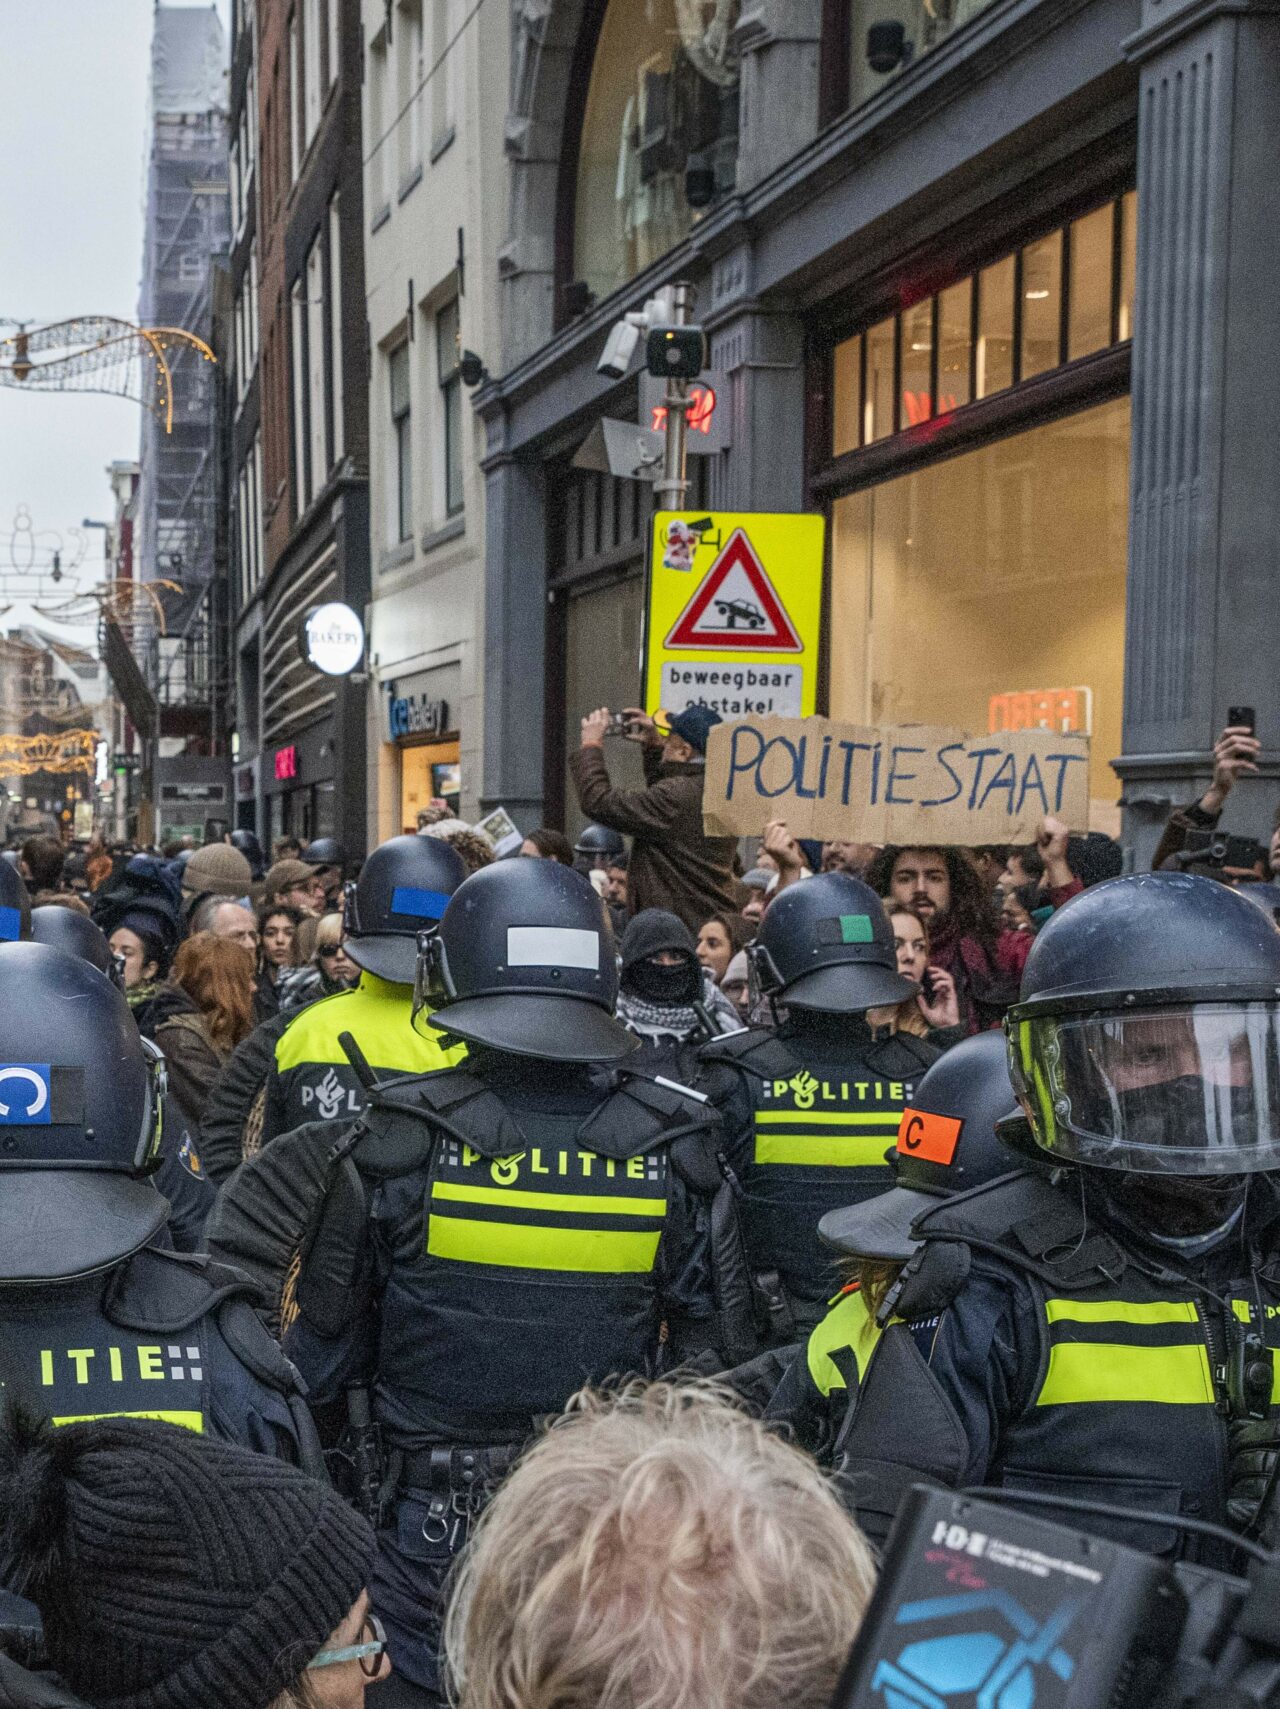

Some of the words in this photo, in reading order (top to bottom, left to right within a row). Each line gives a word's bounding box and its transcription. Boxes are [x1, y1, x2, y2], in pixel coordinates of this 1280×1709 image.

[311, 631, 358, 646] BAKERY
[670, 668, 793, 691] beweegbaar
[905, 1115, 924, 1150] C
